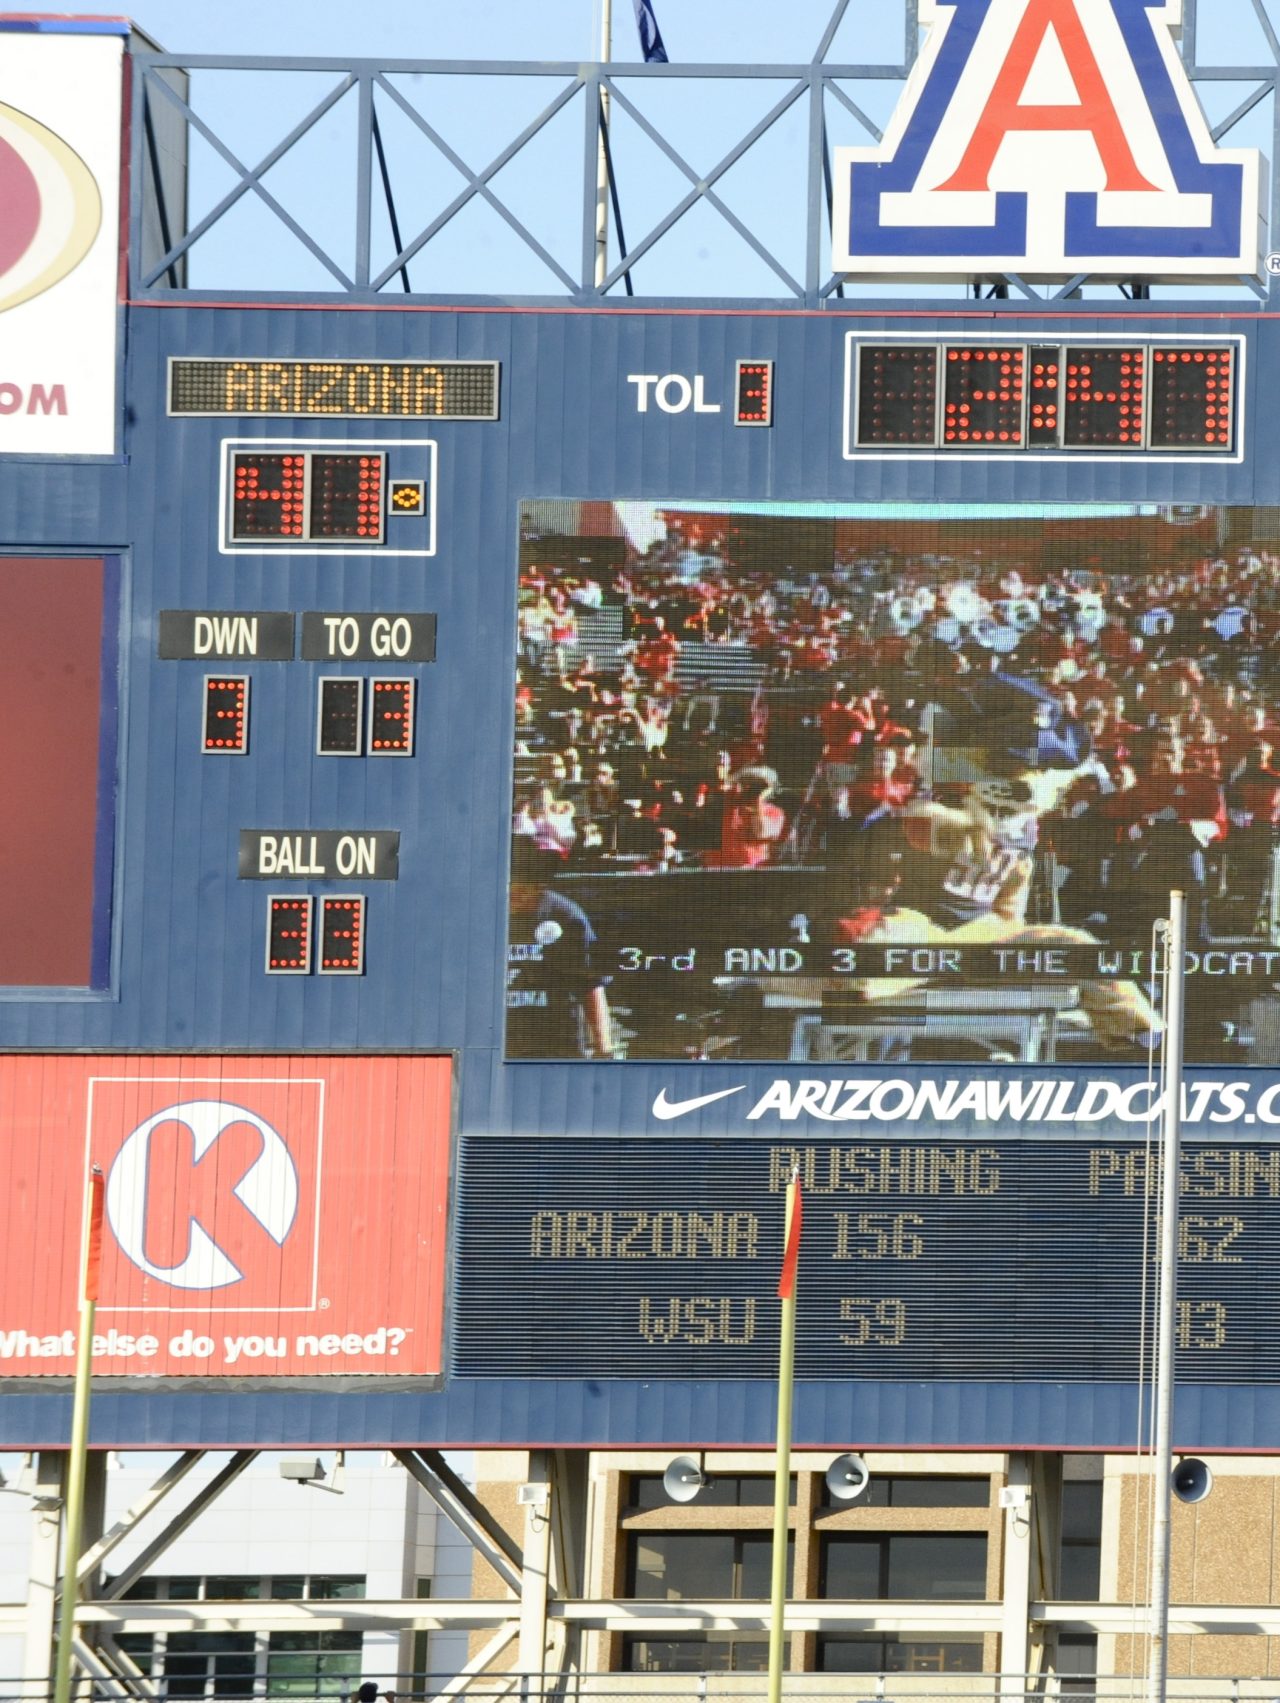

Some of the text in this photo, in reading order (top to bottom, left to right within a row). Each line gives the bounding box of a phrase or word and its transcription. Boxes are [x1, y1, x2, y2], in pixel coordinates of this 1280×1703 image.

[226, 362, 445, 415] ARIZONA
[627, 375, 721, 413] TOL
[740, 367, 769, 419] 3
[194, 617, 257, 655] DWN
[324, 618, 412, 656] TO GO
[207, 682, 245, 747] 3
[374, 683, 411, 748] 3
[258, 836, 376, 875] BALL ON
[618, 947, 696, 972] 3rd
[724, 947, 803, 973] AND
[832, 948, 856, 973] 3
[886, 948, 962, 973] FOR
[993, 949, 1069, 974] THE
[768, 1147, 1001, 1194] RUSHING
[138, 1114, 288, 1284] K
[530, 1211, 759, 1258] ARIZONA
[831, 1213, 924, 1259] 156
[637, 1297, 755, 1345] WSU
[839, 1299, 906, 1345] 59
[91, 1328, 159, 1357] else
[168, 1329, 216, 1358] do
[224, 1333, 287, 1363] you
[295, 1327, 406, 1357] need?
